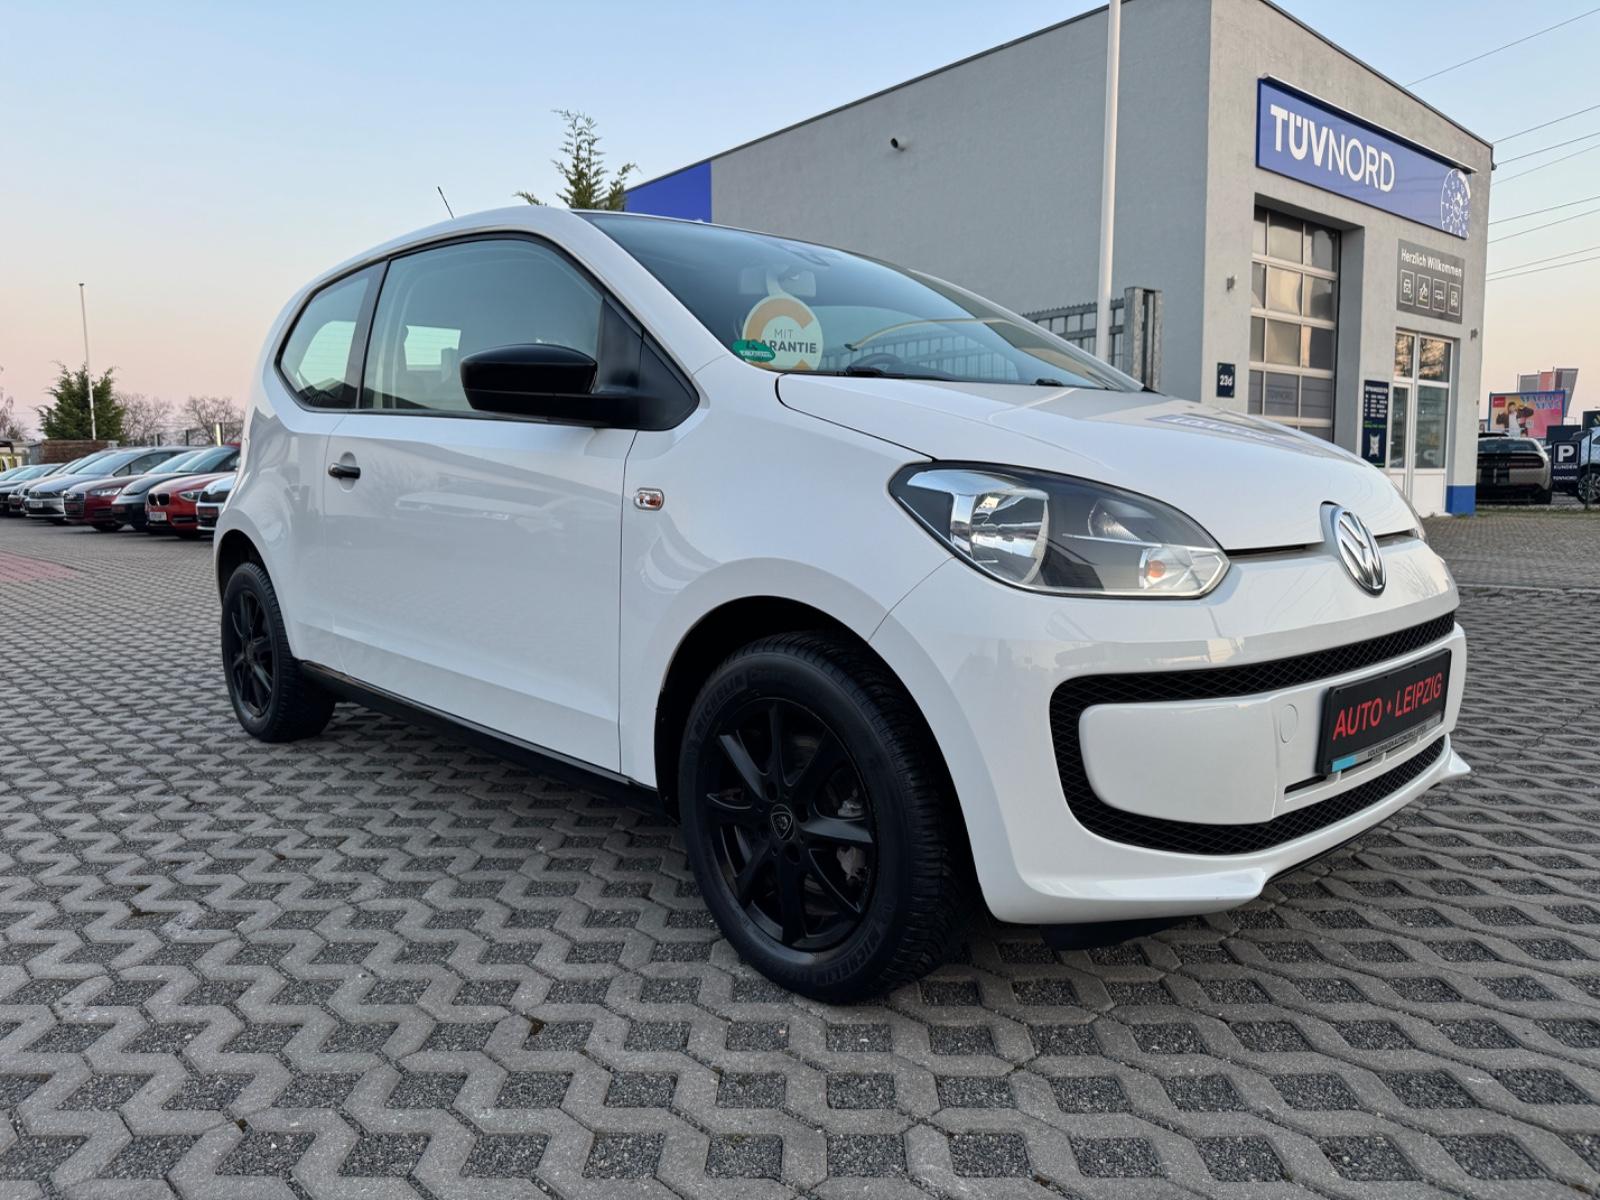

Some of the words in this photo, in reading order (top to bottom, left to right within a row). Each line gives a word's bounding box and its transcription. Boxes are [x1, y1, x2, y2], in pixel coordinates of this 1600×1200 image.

[1401, 247, 1426, 267] Herzlich
[1427, 256, 1462, 277] Willkommen
[774, 328, 793, 338] MIT
[760, 339, 817, 353] ARANTIE
[1557, 445, 1574, 462] P
[1332, 697, 1382, 741] AUTO
[1394, 672, 1443, 718] LEIPZIG
